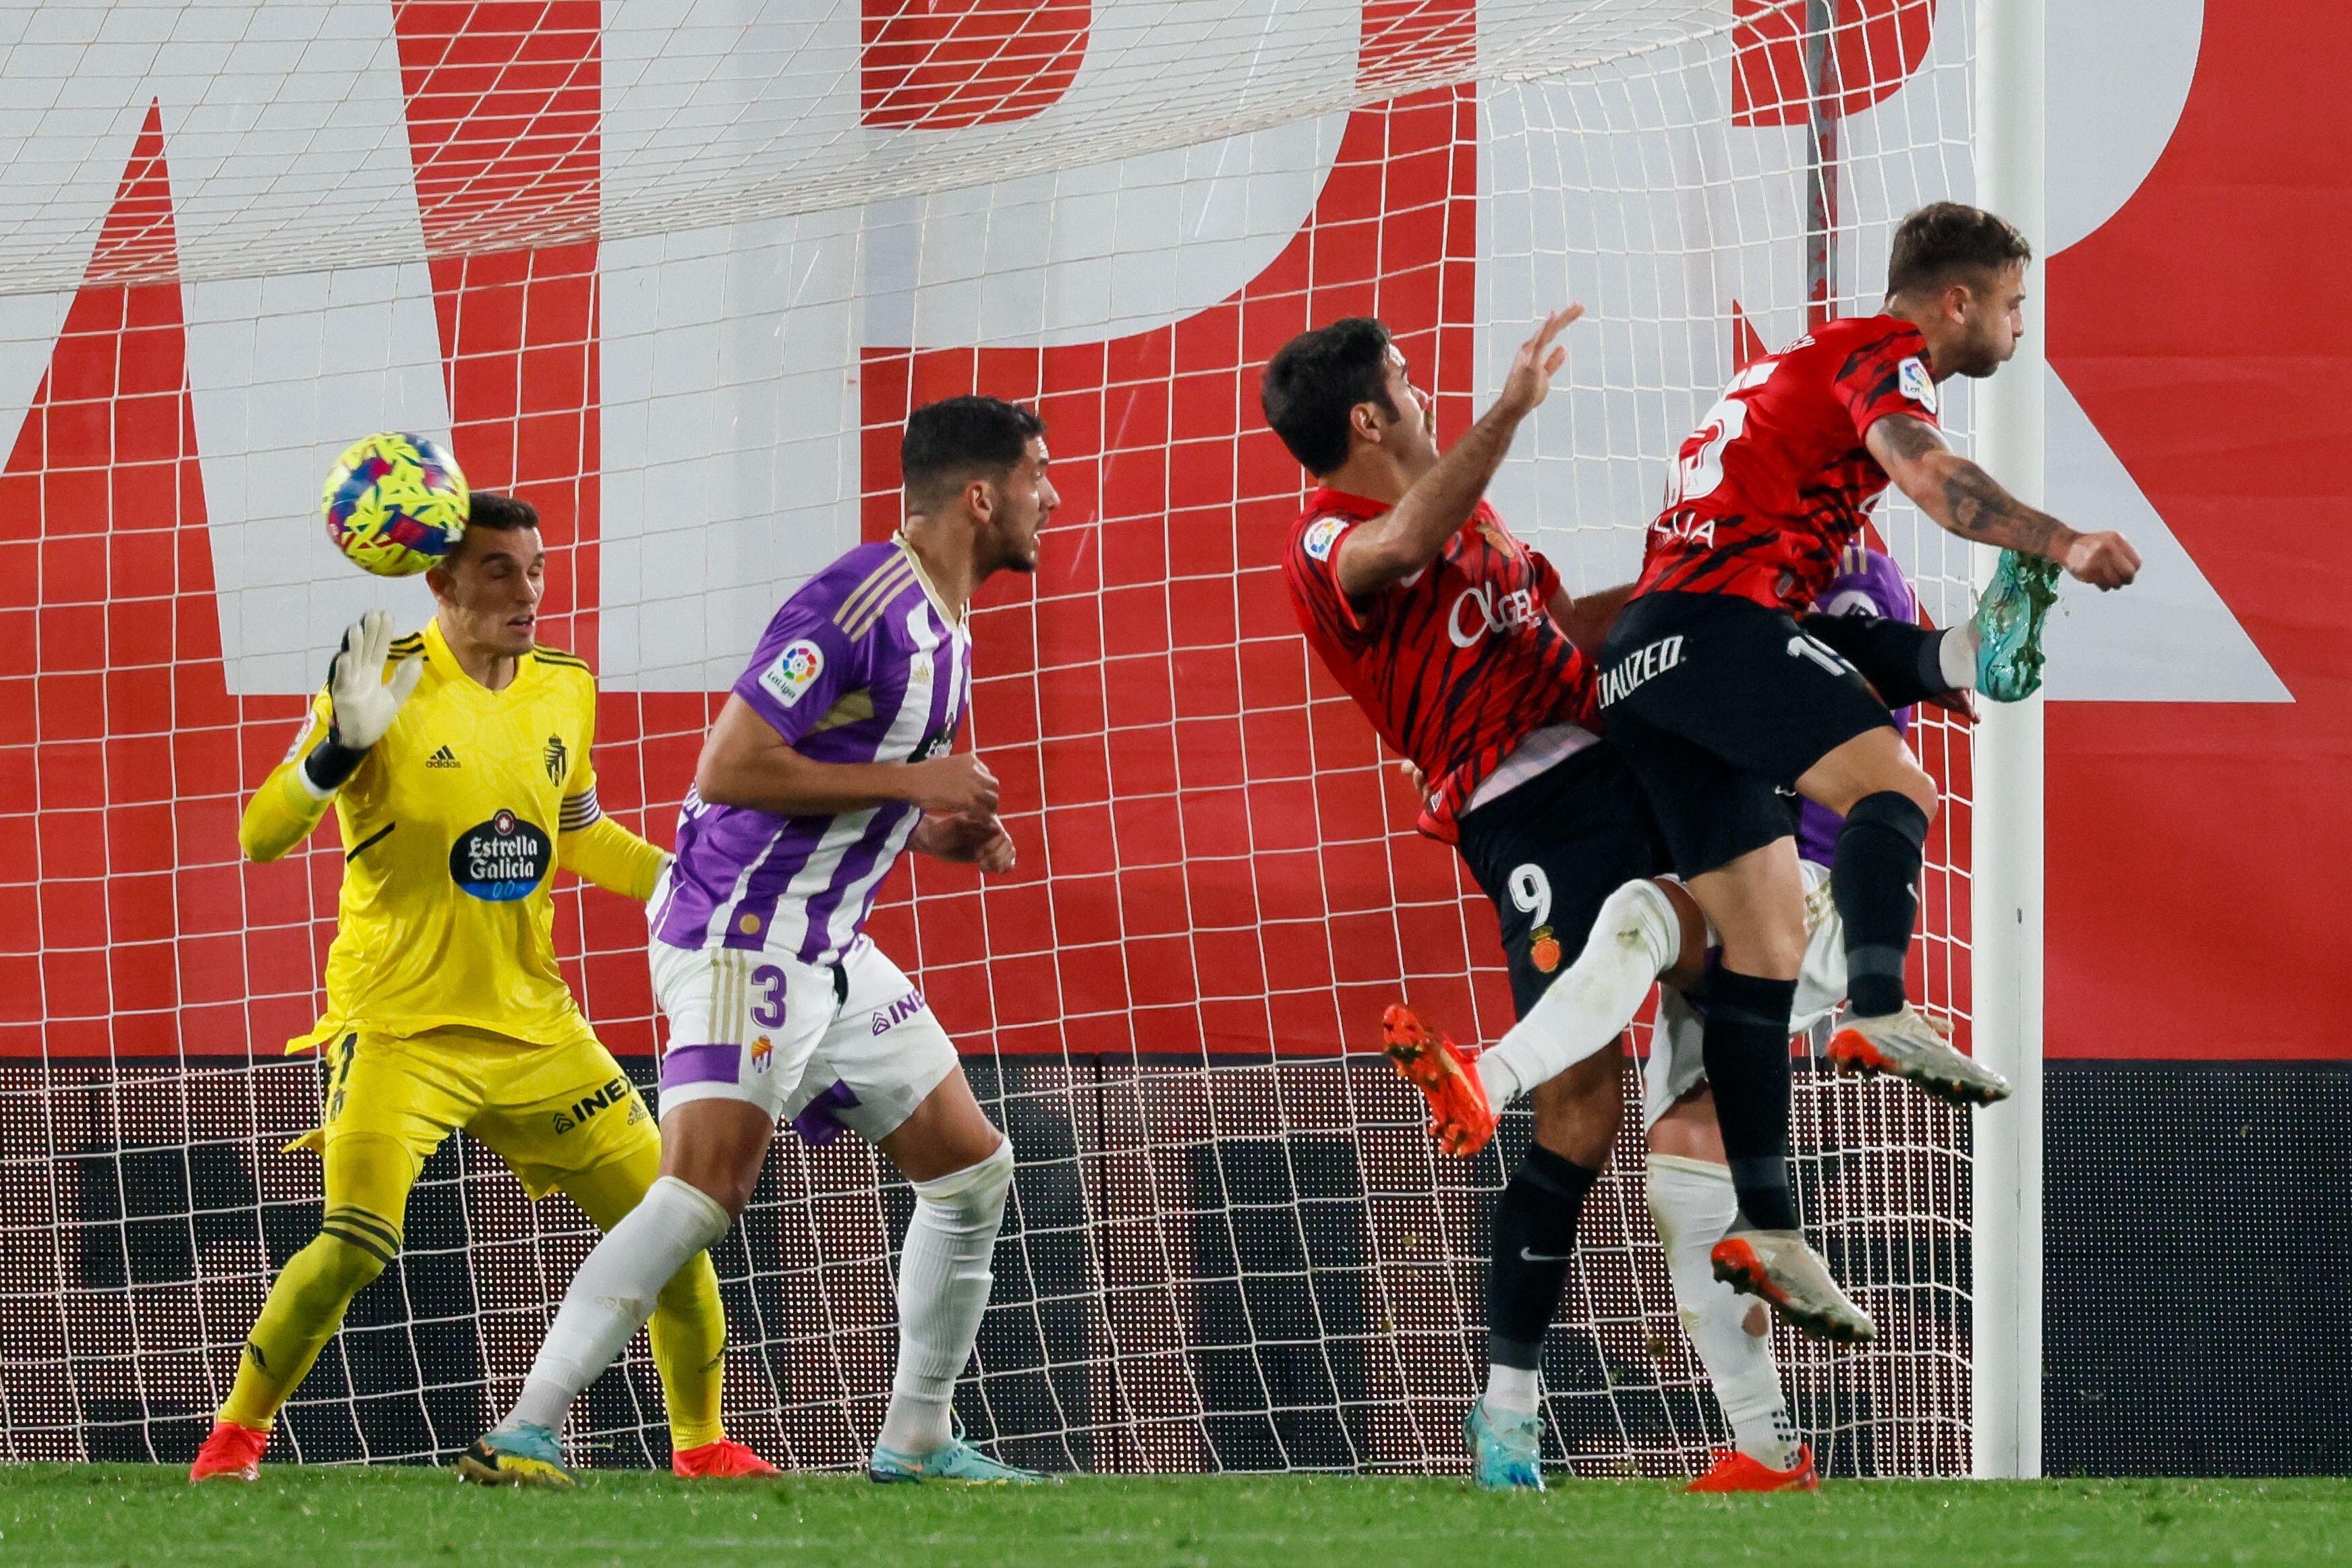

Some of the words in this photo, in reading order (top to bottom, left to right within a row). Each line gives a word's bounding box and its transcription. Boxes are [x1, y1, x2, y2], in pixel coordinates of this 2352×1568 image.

[1651, 511, 1716, 550] LUA
[767, 671, 797, 699] LaLiga
[426, 760, 462, 769] adidas
[468, 835, 538, 859] Estrella
[469, 856, 535, 879] Galicia
[1508, 863, 1552, 931] 9
[751, 964, 787, 1030] 3
